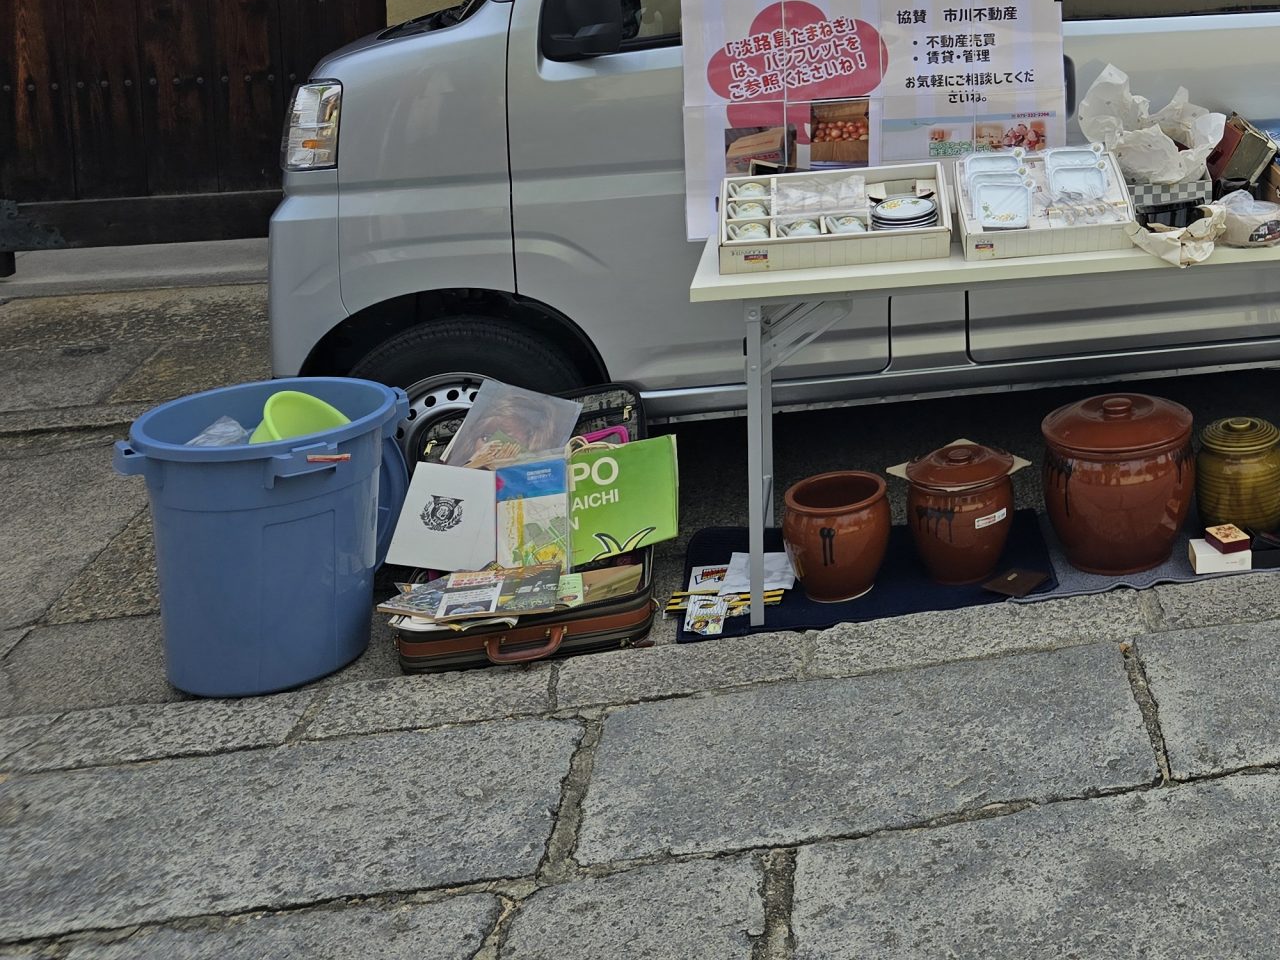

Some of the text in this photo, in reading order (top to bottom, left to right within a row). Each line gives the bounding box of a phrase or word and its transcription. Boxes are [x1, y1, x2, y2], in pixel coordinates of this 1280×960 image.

[896, 6, 1018, 25] 協賛 市川不動産
[725, 16, 856, 57] 「淡路島たまねぎ」
[926, 33, 996, 49] 不動産売買
[731, 37, 860, 78] は、パンフレットを
[926, 49, 991, 65] 賃貸・管理
[905, 69, 1035, 88] お気軽にご相談してくだ
[947, 89, 988, 103] さいね。
[571, 488, 620, 512] AICHI
